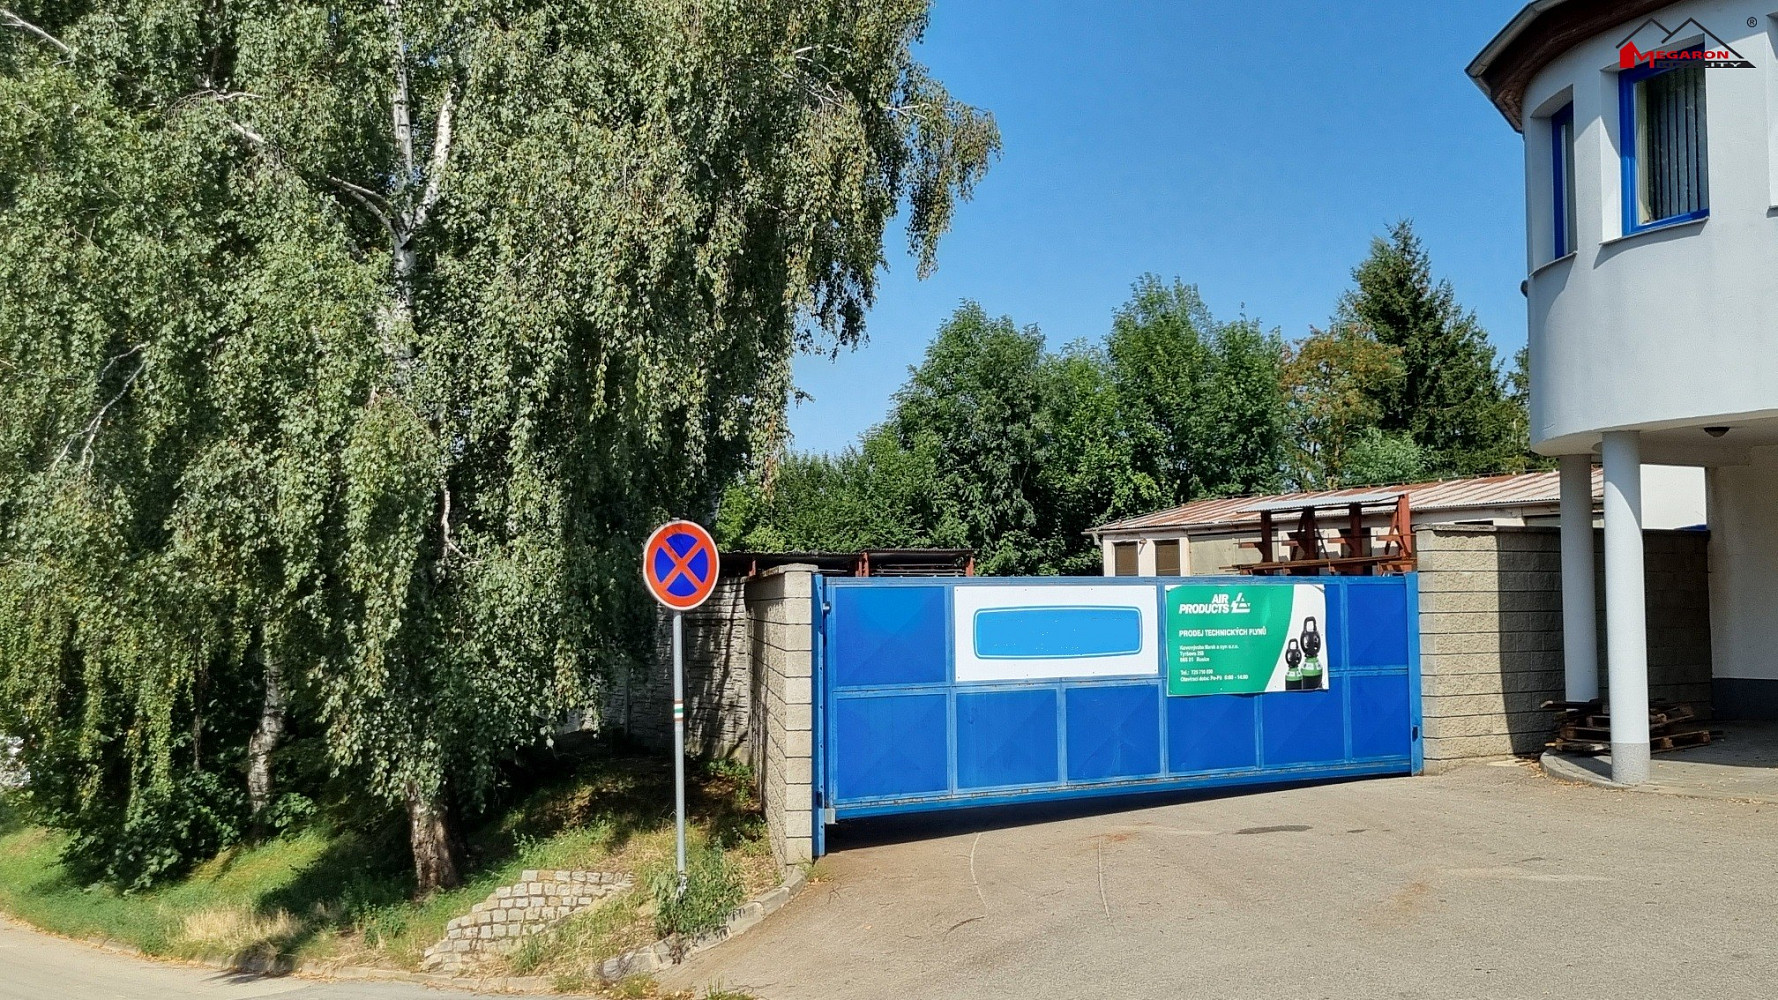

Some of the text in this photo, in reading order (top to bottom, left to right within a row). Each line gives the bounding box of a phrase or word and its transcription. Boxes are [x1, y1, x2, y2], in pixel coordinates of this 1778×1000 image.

[1212, 594, 1228, 603] AIR
[1179, 604, 1229, 614] PRODUCTS
[1179, 626, 1267, 637] PRODEJ TECHNICKÝCH PLYNŮ
